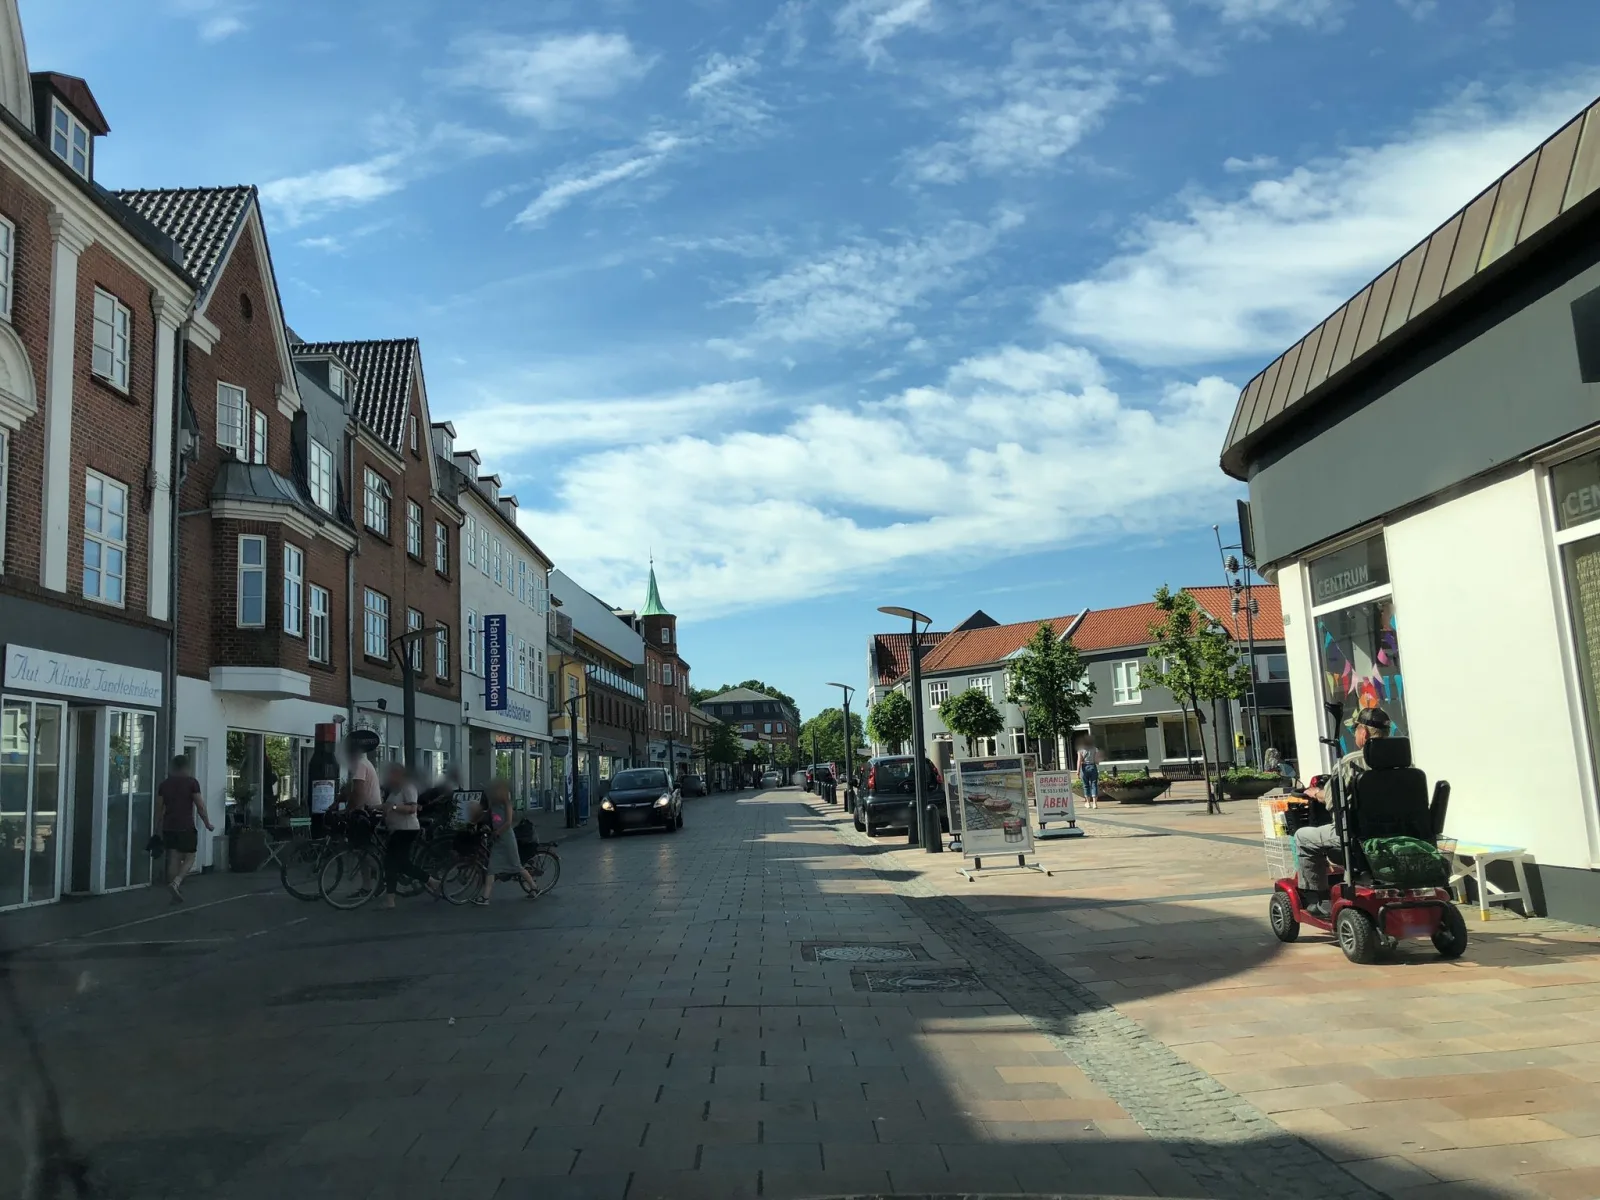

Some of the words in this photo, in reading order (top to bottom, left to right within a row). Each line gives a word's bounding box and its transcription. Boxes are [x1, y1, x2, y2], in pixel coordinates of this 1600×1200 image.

[1318, 564, 1369, 597] CENTRUM
[44, 659, 91, 690] Klinisk
[93, 668, 160, 699] Tandtekniker
[489, 617, 501, 707] Handelsbanken
[1043, 795, 1068, 808] ÅBEN
